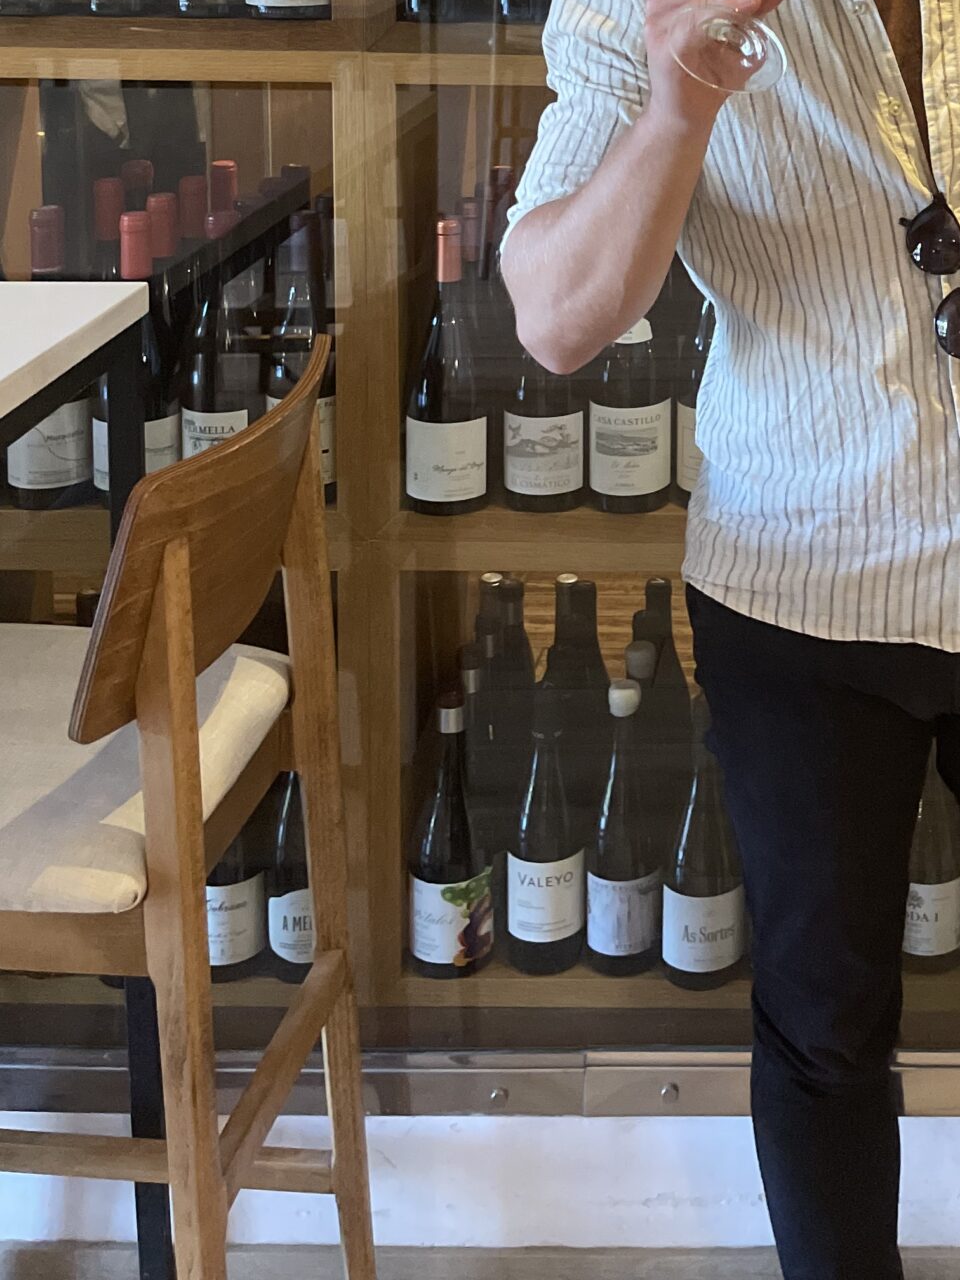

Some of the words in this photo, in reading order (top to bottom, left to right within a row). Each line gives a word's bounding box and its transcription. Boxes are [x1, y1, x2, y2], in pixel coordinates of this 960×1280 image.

[614, 414, 662, 426] CASTILLO
[517, 871, 574, 888] VALEYO
[282, 915, 289, 931] A
[681, 924, 698, 943] As
